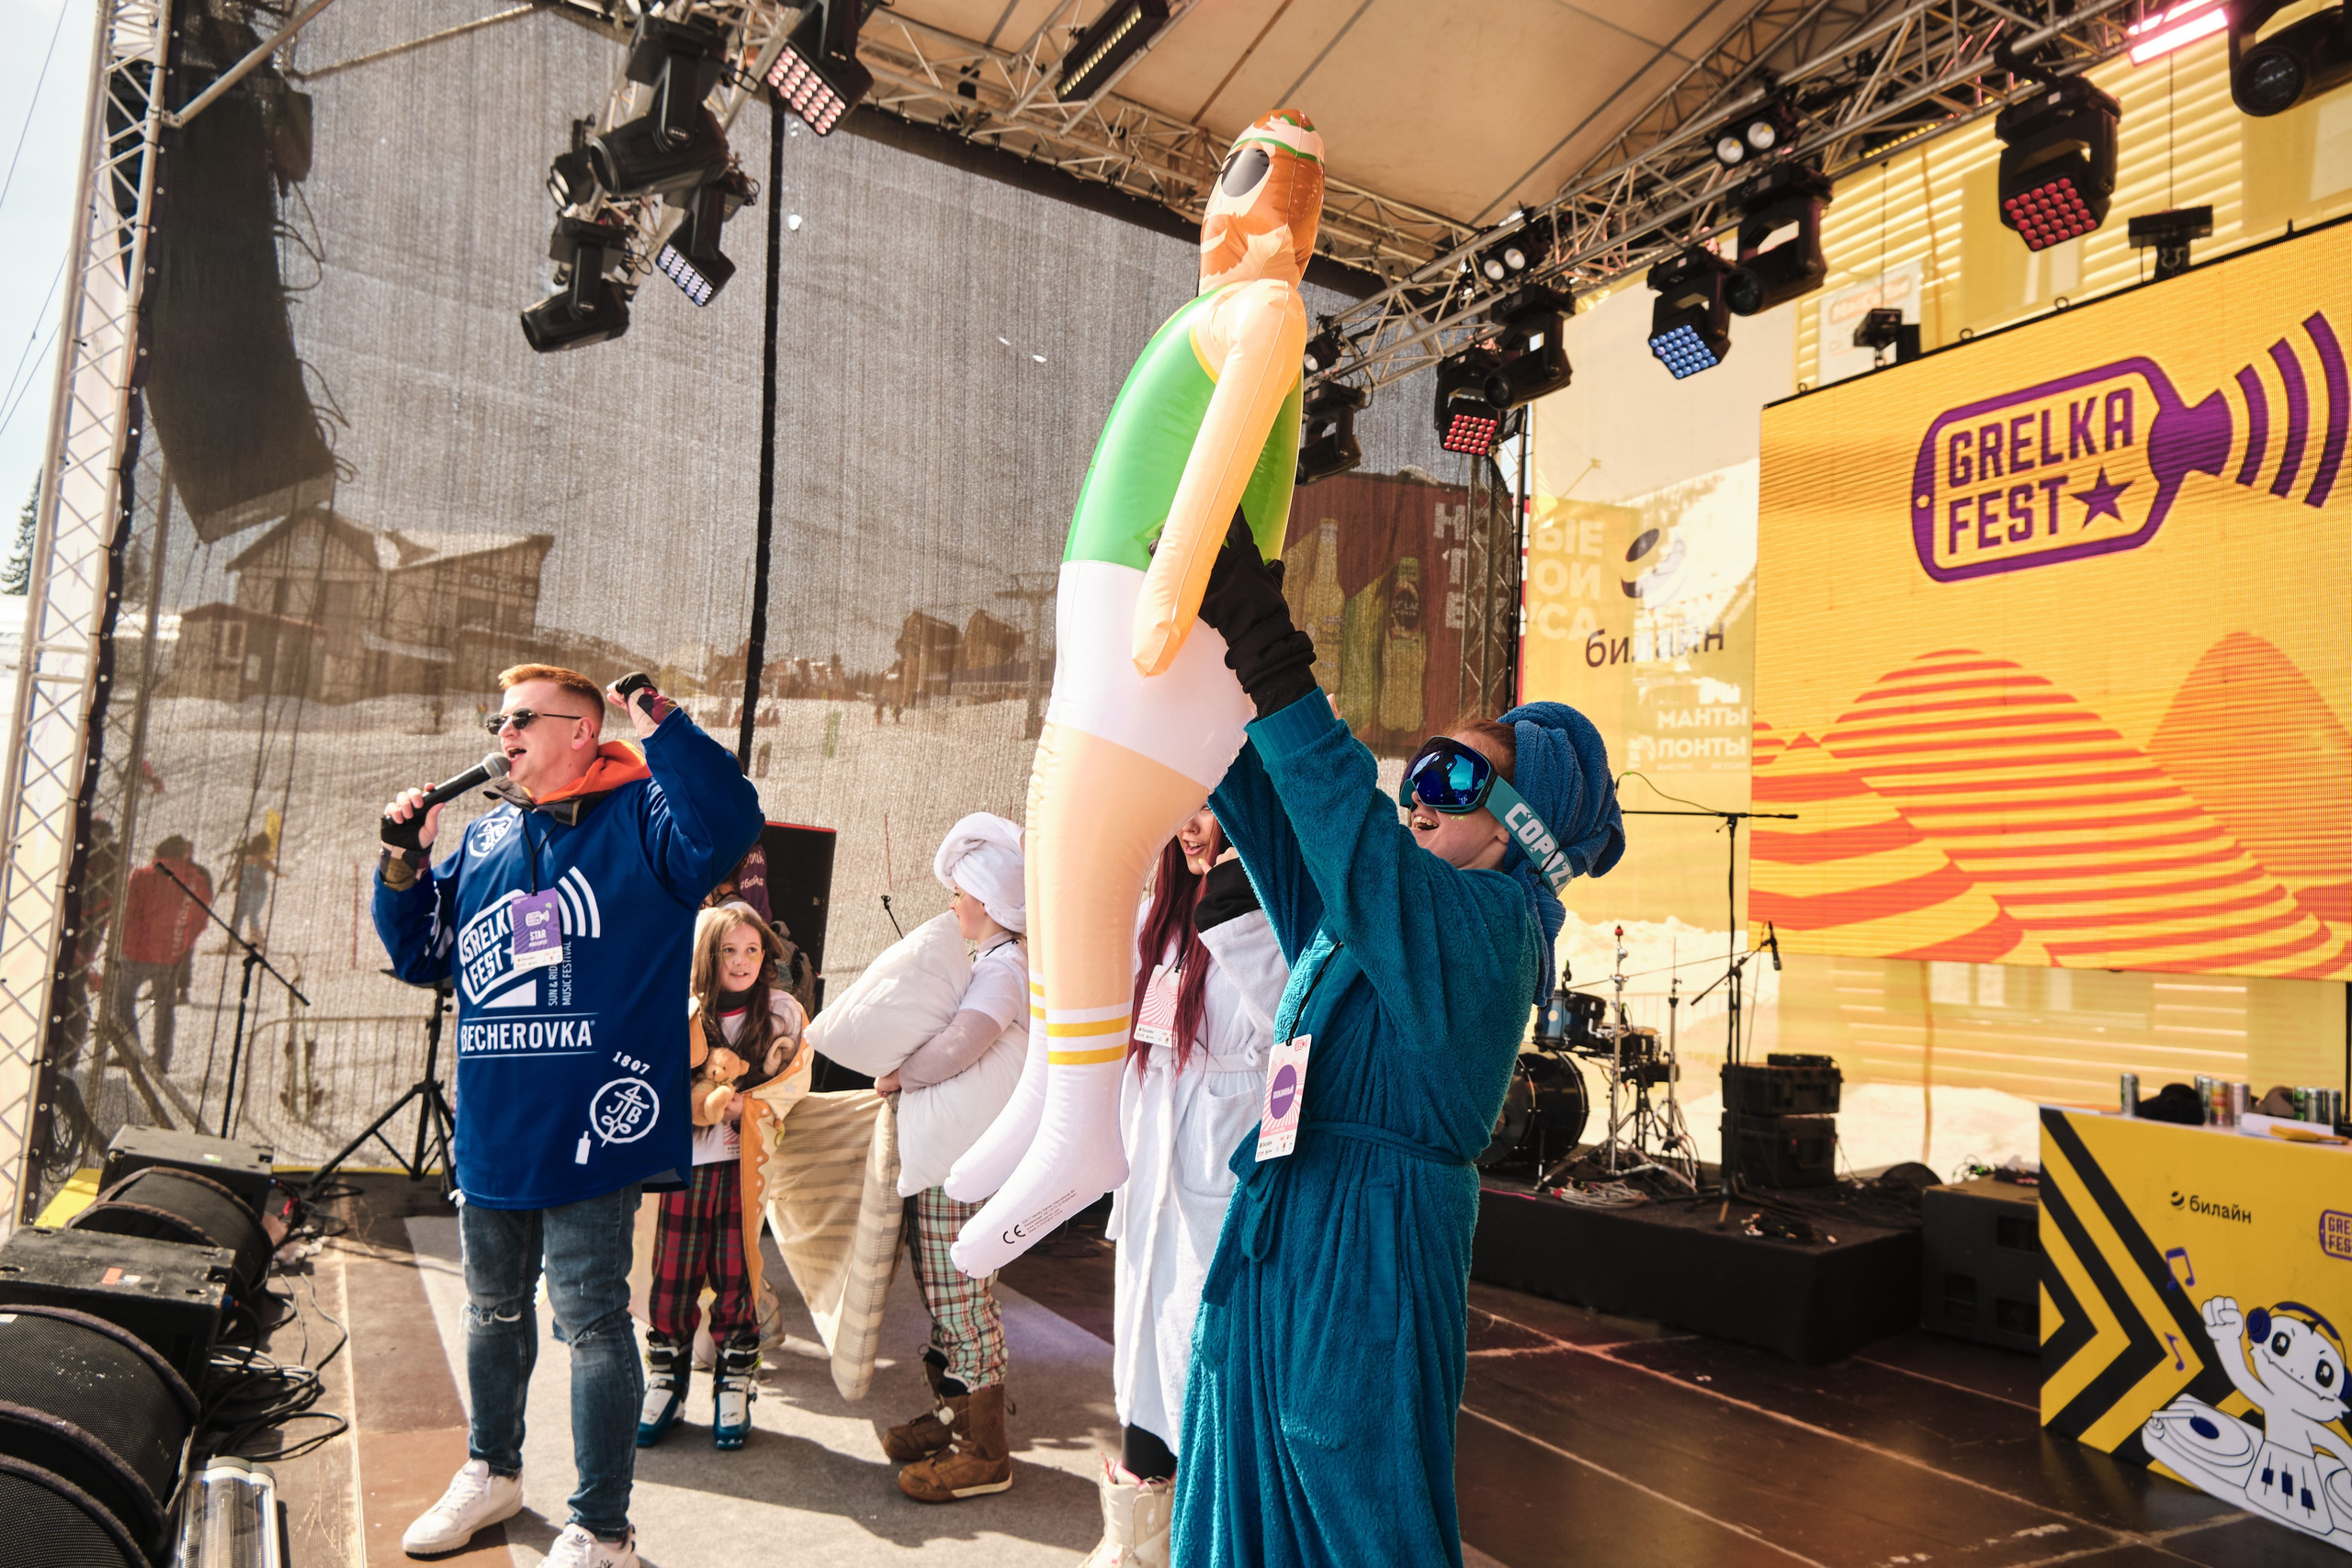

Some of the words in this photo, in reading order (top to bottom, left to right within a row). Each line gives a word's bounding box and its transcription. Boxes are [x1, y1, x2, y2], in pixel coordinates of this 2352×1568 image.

[1949, 387, 2134, 489] GRELKA
[1949, 475, 2070, 556] FEST
[1657, 706, 1747, 729] МАНТЫ
[1657, 736, 1747, 758] ПОНТЫ
[463, 904, 514, 964] GRELK
[529, 929, 547, 941] STAR
[469, 942, 504, 992] FEST
[548, 963, 559, 980] RID
[561, 940, 572, 979] FESTIVAL
[548, 989, 559, 1007] SUN
[561, 980, 572, 1007] MUSIC
[460, 1021, 594, 1054] BECHEROVKA
[612, 1051, 650, 1075] 1807
[2189, 1195, 2252, 1224] билайн
[1002, 1224, 1026, 1245] CE
